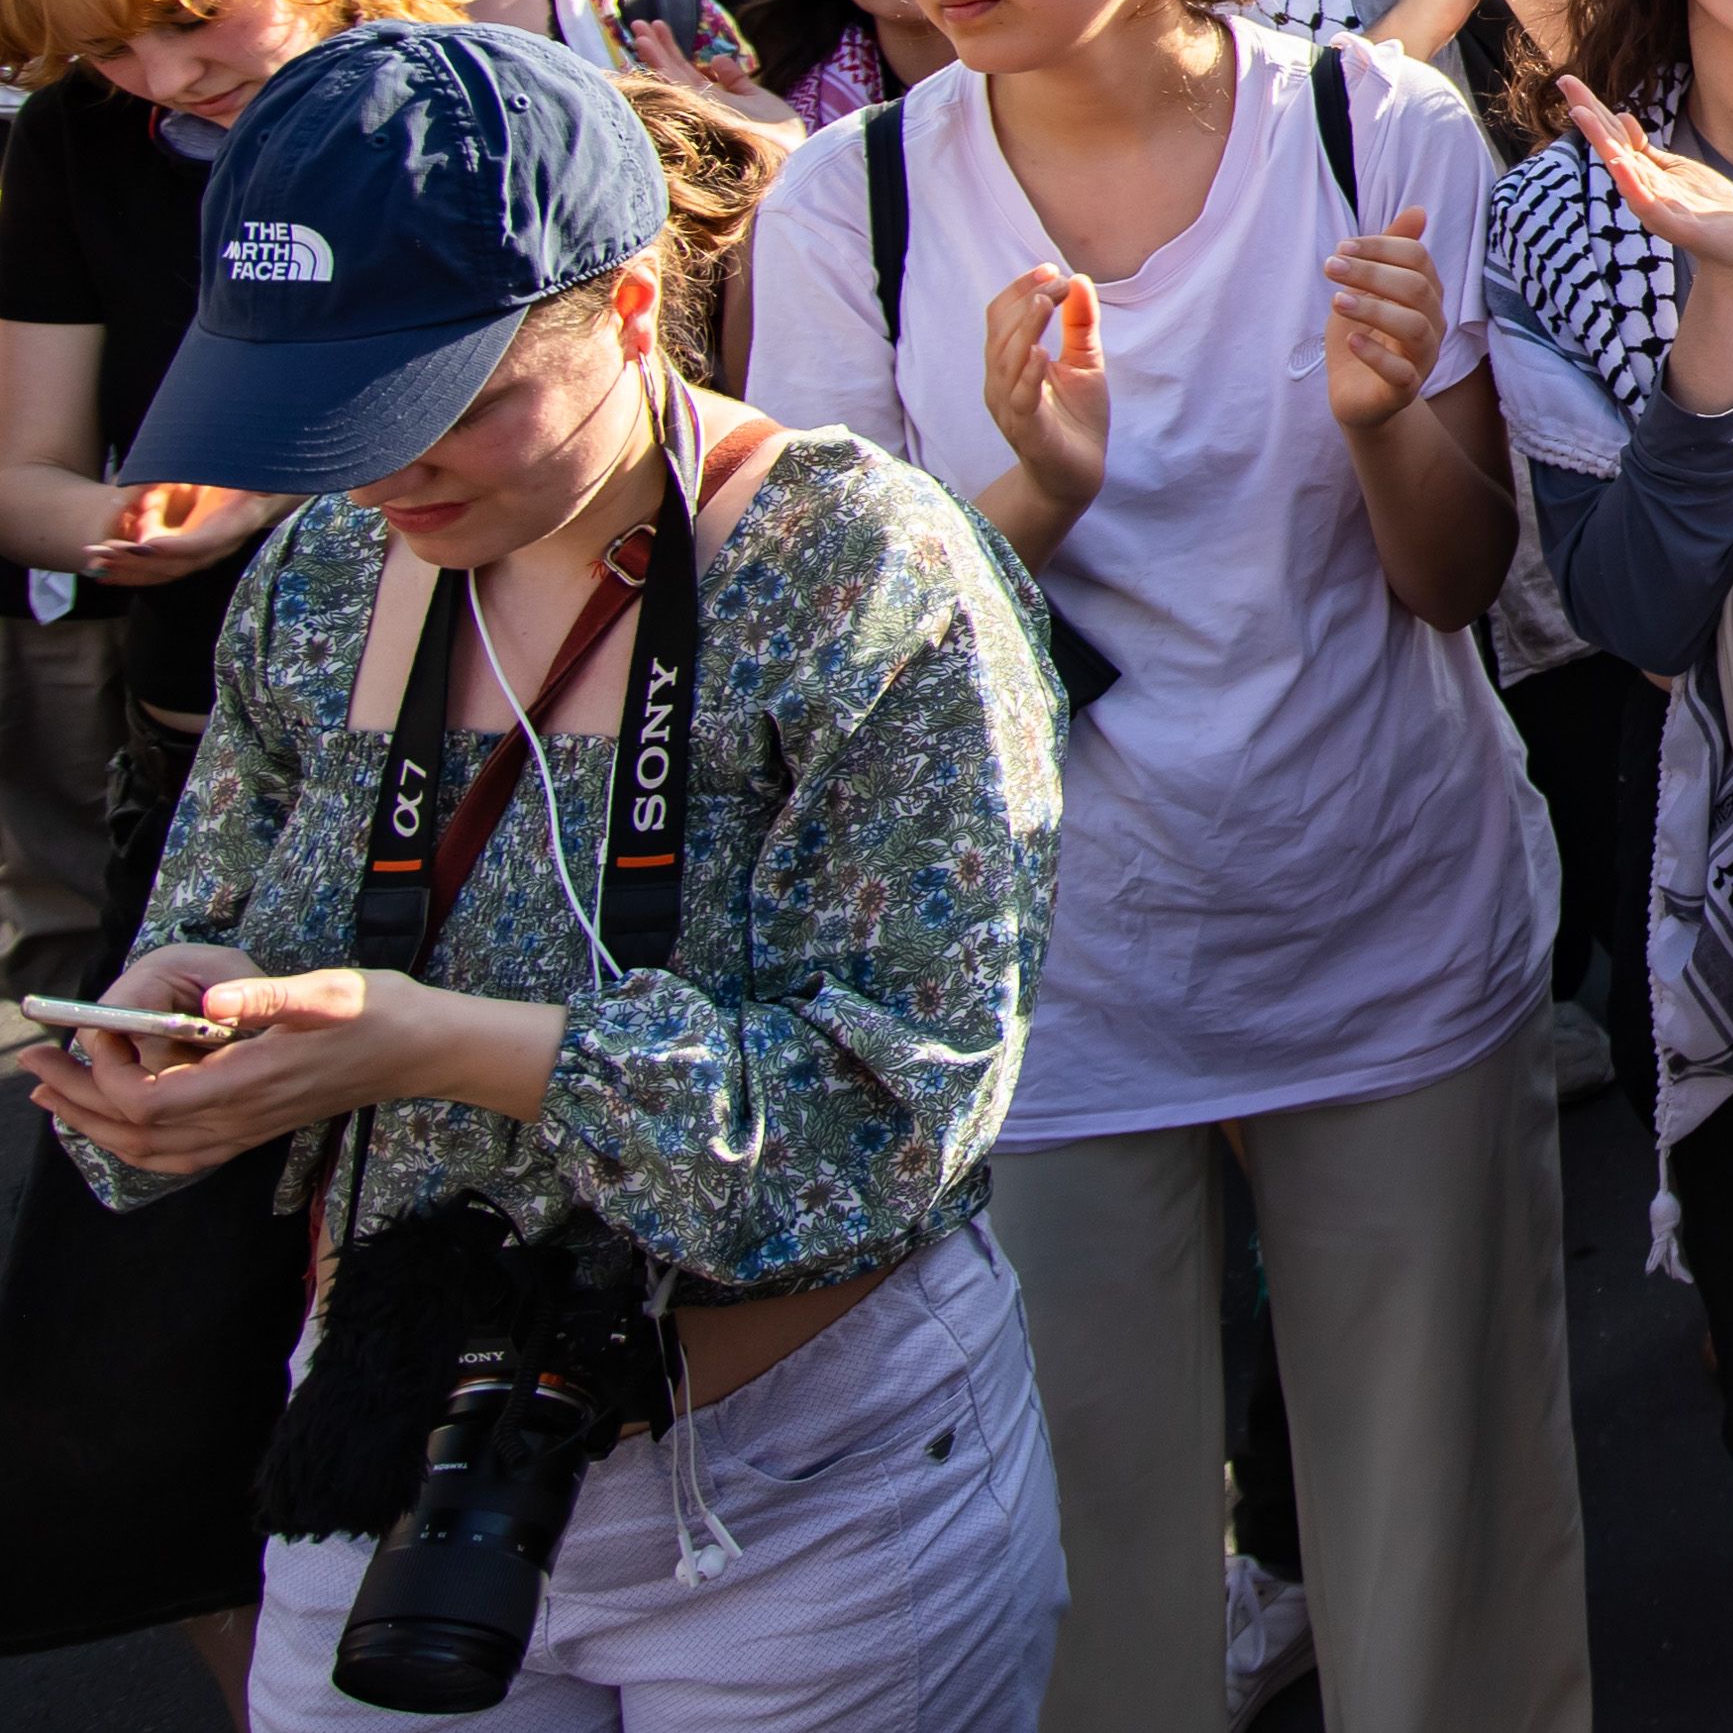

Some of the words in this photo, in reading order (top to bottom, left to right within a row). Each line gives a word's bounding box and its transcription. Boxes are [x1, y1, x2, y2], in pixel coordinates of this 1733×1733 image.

[243, 221, 290, 241] THE
[231, 261, 288, 281] FACE
[633, 657, 678, 832] SONY
